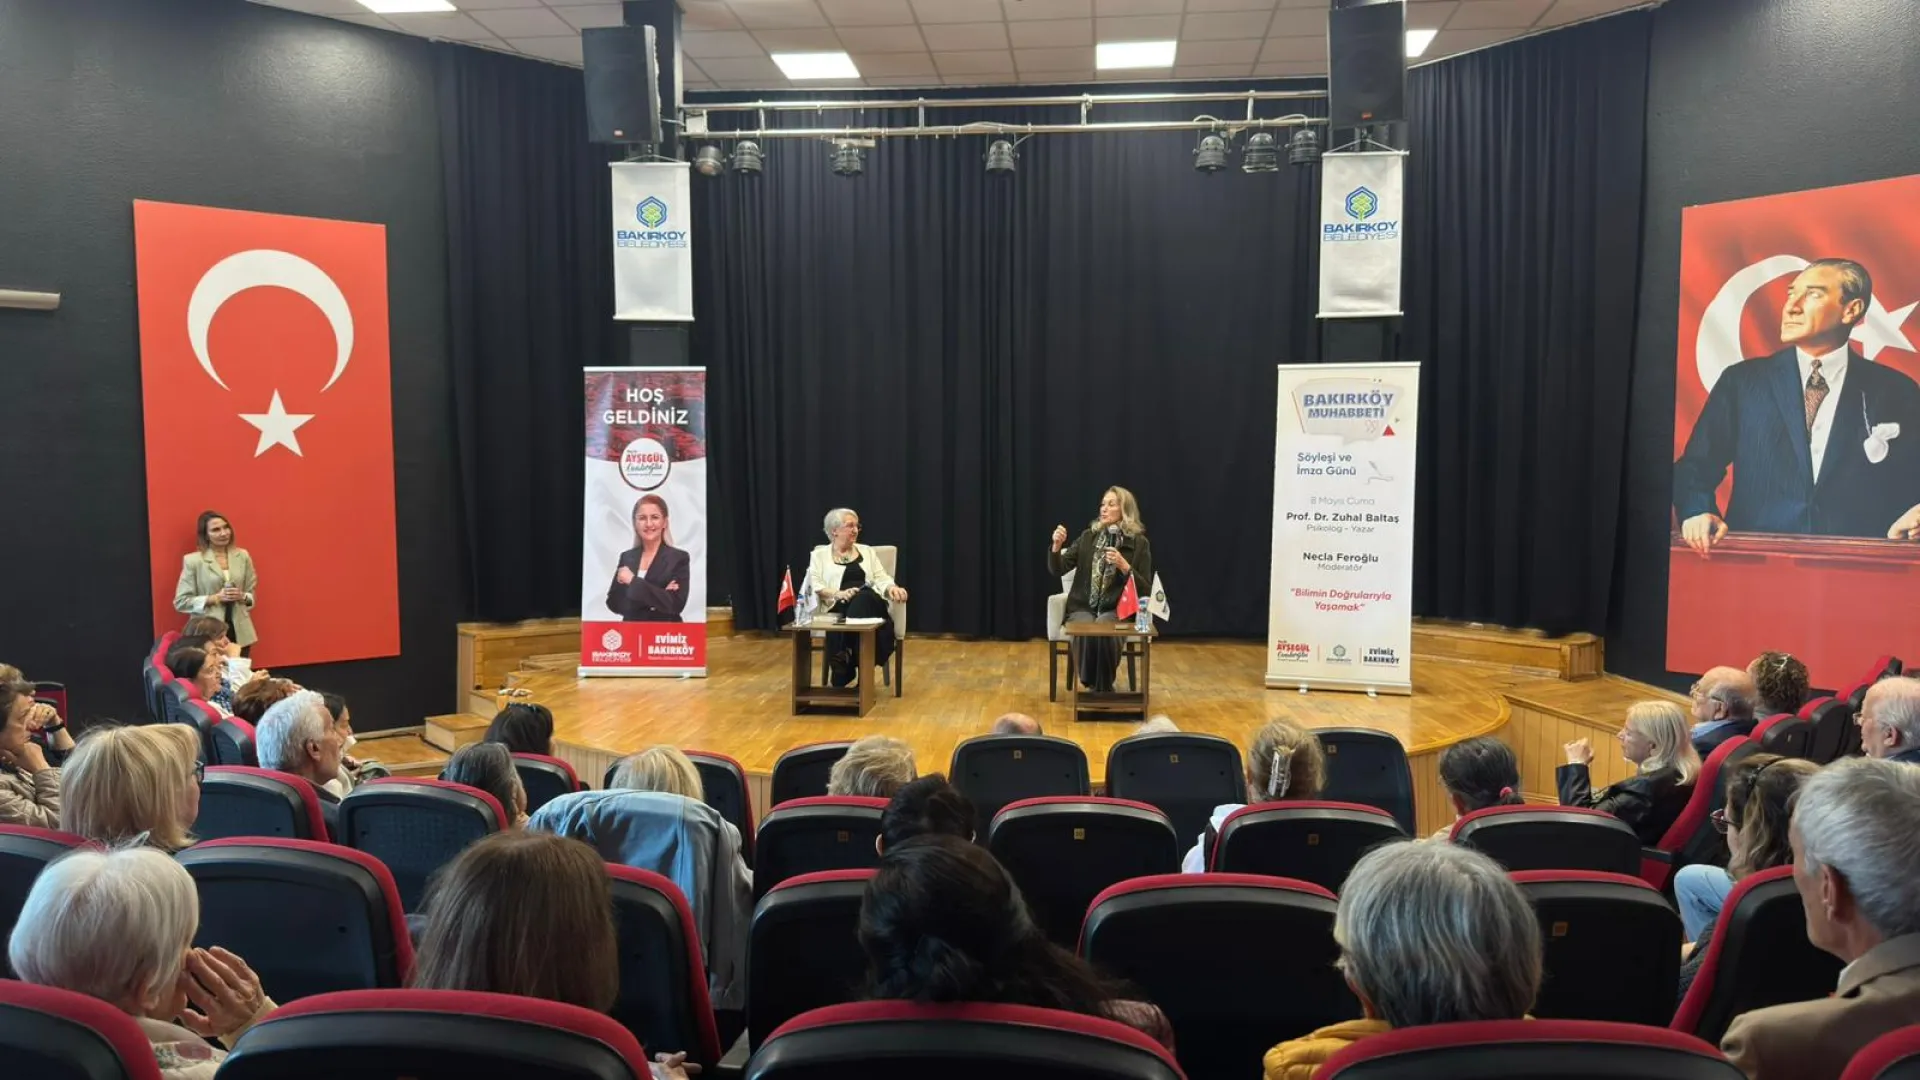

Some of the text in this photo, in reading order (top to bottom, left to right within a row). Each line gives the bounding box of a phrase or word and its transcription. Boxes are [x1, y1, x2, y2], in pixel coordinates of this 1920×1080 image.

[626, 388, 665, 405] HOŞ
[1303, 390, 1395, 407] BAKIRKÖY
[602, 406, 689, 425] GELDİNİZ
[1307, 406, 1385, 419] MUHABBETİ
[1297, 452, 1353, 463] Söyleşi ve
[1296, 464, 1357, 476] İmza Günü
[1286, 512, 1400, 523] Prof. Dr. Zuhal Baltaş
[1306, 524, 1343, 533] Psikolog
[1351, 525, 1375, 533] Yazar
[1303, 552, 1379, 564] Necla Feroğlu
[1329, 589, 1392, 601] Doğrularıyla
[647, 644, 695, 655] BAKIRKÖY
